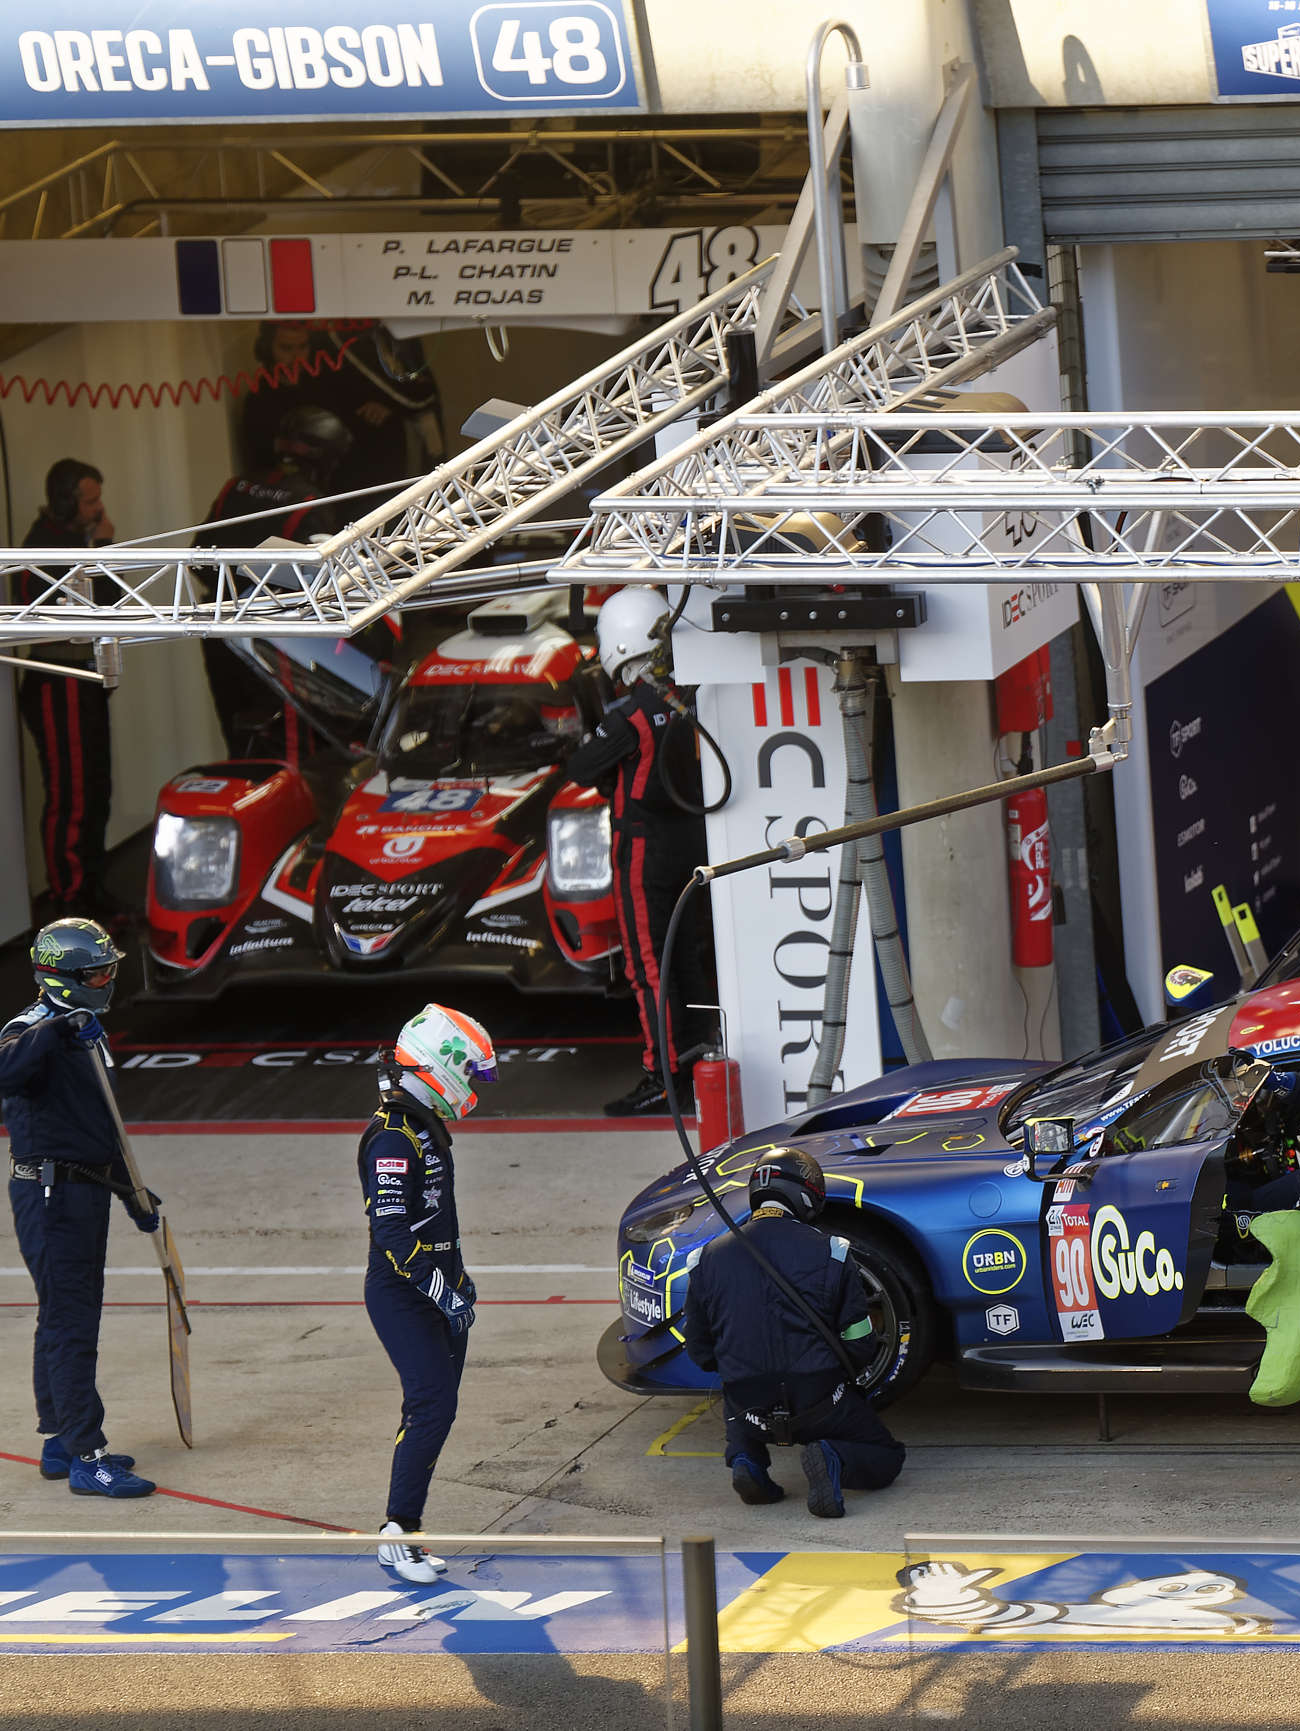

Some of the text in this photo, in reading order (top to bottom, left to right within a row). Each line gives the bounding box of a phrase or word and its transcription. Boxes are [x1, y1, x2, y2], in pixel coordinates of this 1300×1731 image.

[18, 16, 608, 93] ORECA-GIBSON 48
[381, 238, 575, 255] P. LAFARGUE
[393, 262, 559, 280] P-L. CHATIN
[649, 224, 760, 313] 48
[406, 288, 544, 306] M. ROJAS
[390, 788, 473, 812] 48
[329, 882, 440, 898] IDEC SPORT
[1252, 1034, 1300, 1057] YOLUC
[1061, 1213, 1089, 1227] TOTAL
[972, 1249, 1016, 1268] URBN
[1090, 1204, 1184, 1300] SuCo.
[1055, 1238, 1090, 1307] 90
[630, 1289, 662, 1322] Lifestyle
[991, 1313, 1012, 1326] TF
[1071, 1313, 1095, 1329] WEC
[95, 1470, 112, 1483] OMP
